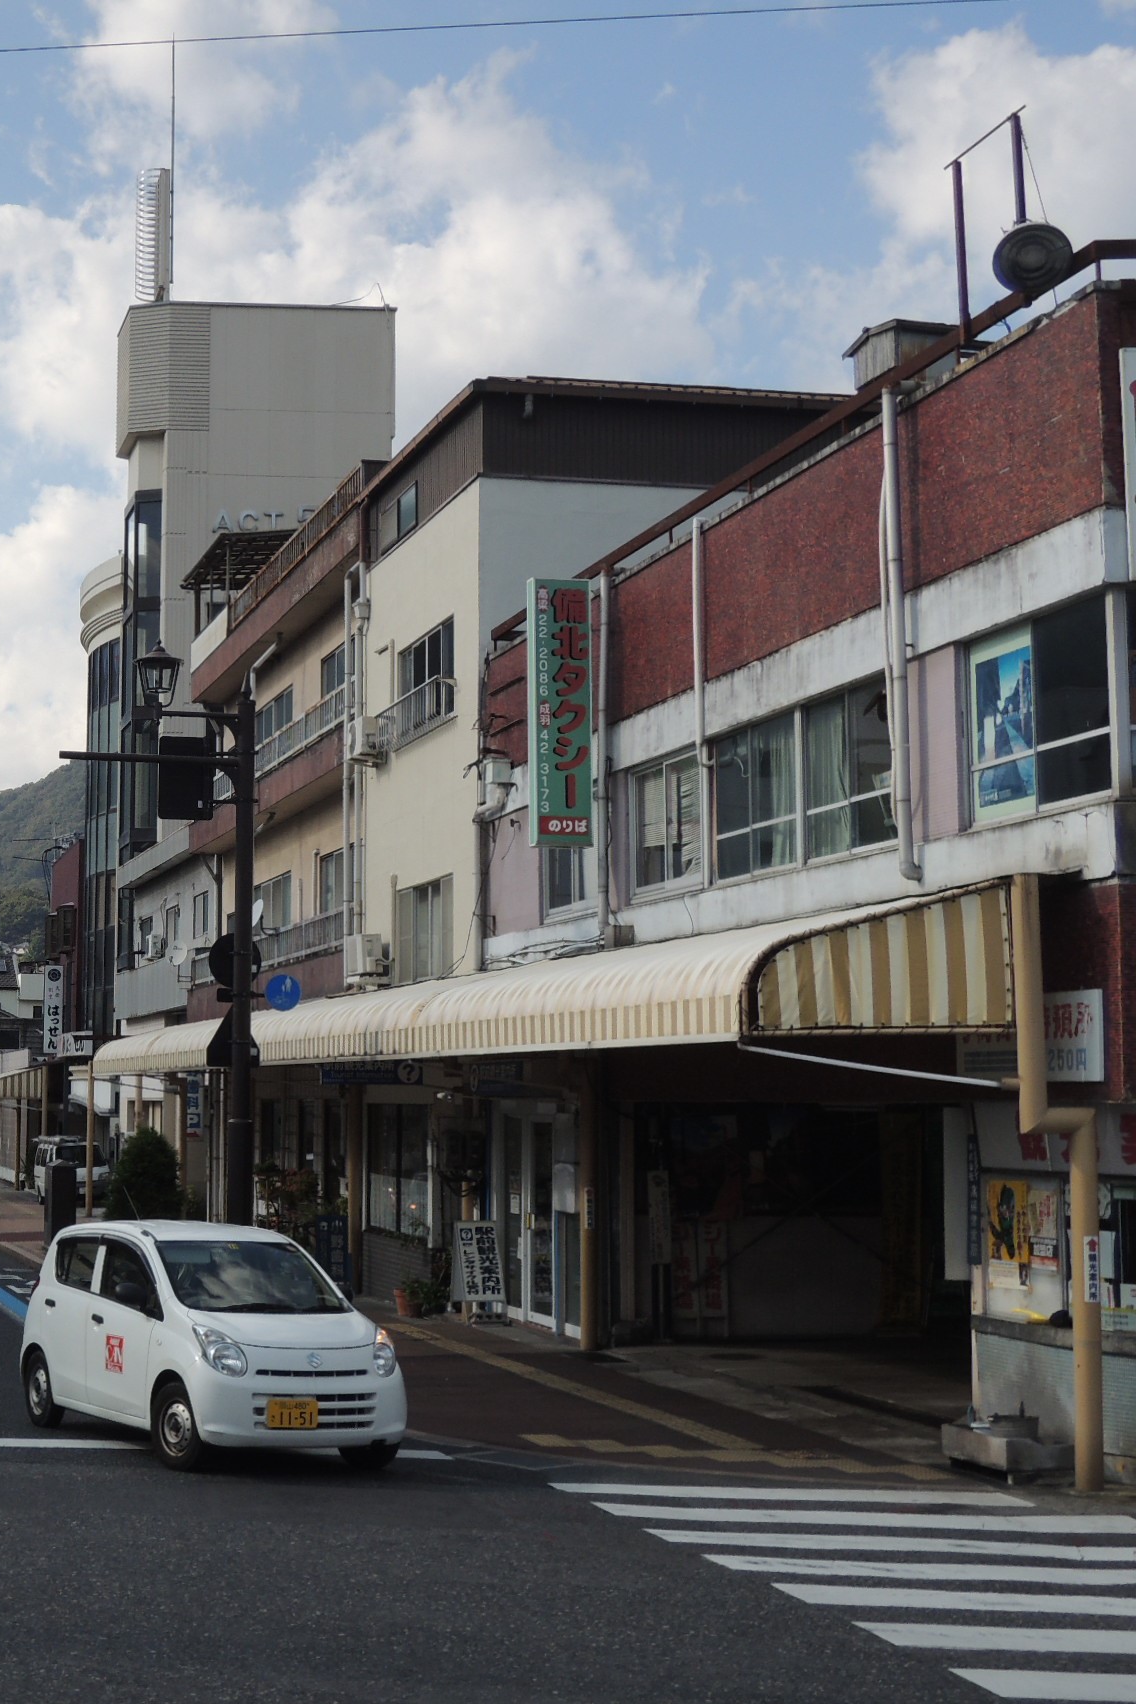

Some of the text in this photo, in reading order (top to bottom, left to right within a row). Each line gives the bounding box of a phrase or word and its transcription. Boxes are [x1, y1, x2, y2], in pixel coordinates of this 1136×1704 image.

[212, 508, 284, 533] ACT
[538, 588, 549, 611] 高梁
[551, 588, 589, 808] 備北タクシー
[539, 703, 551, 726] 成羽
[548, 819, 588, 833] のりば
[47, 1005, 60, 1049] はっせん
[1048, 1048, 1087, 1071] 250円
[475, 1226, 502, 1295] 駅前観光案内所
[1088, 1253, 1098, 1301] 観光案内所
[280, 1411, 313, 1426] 11-51
